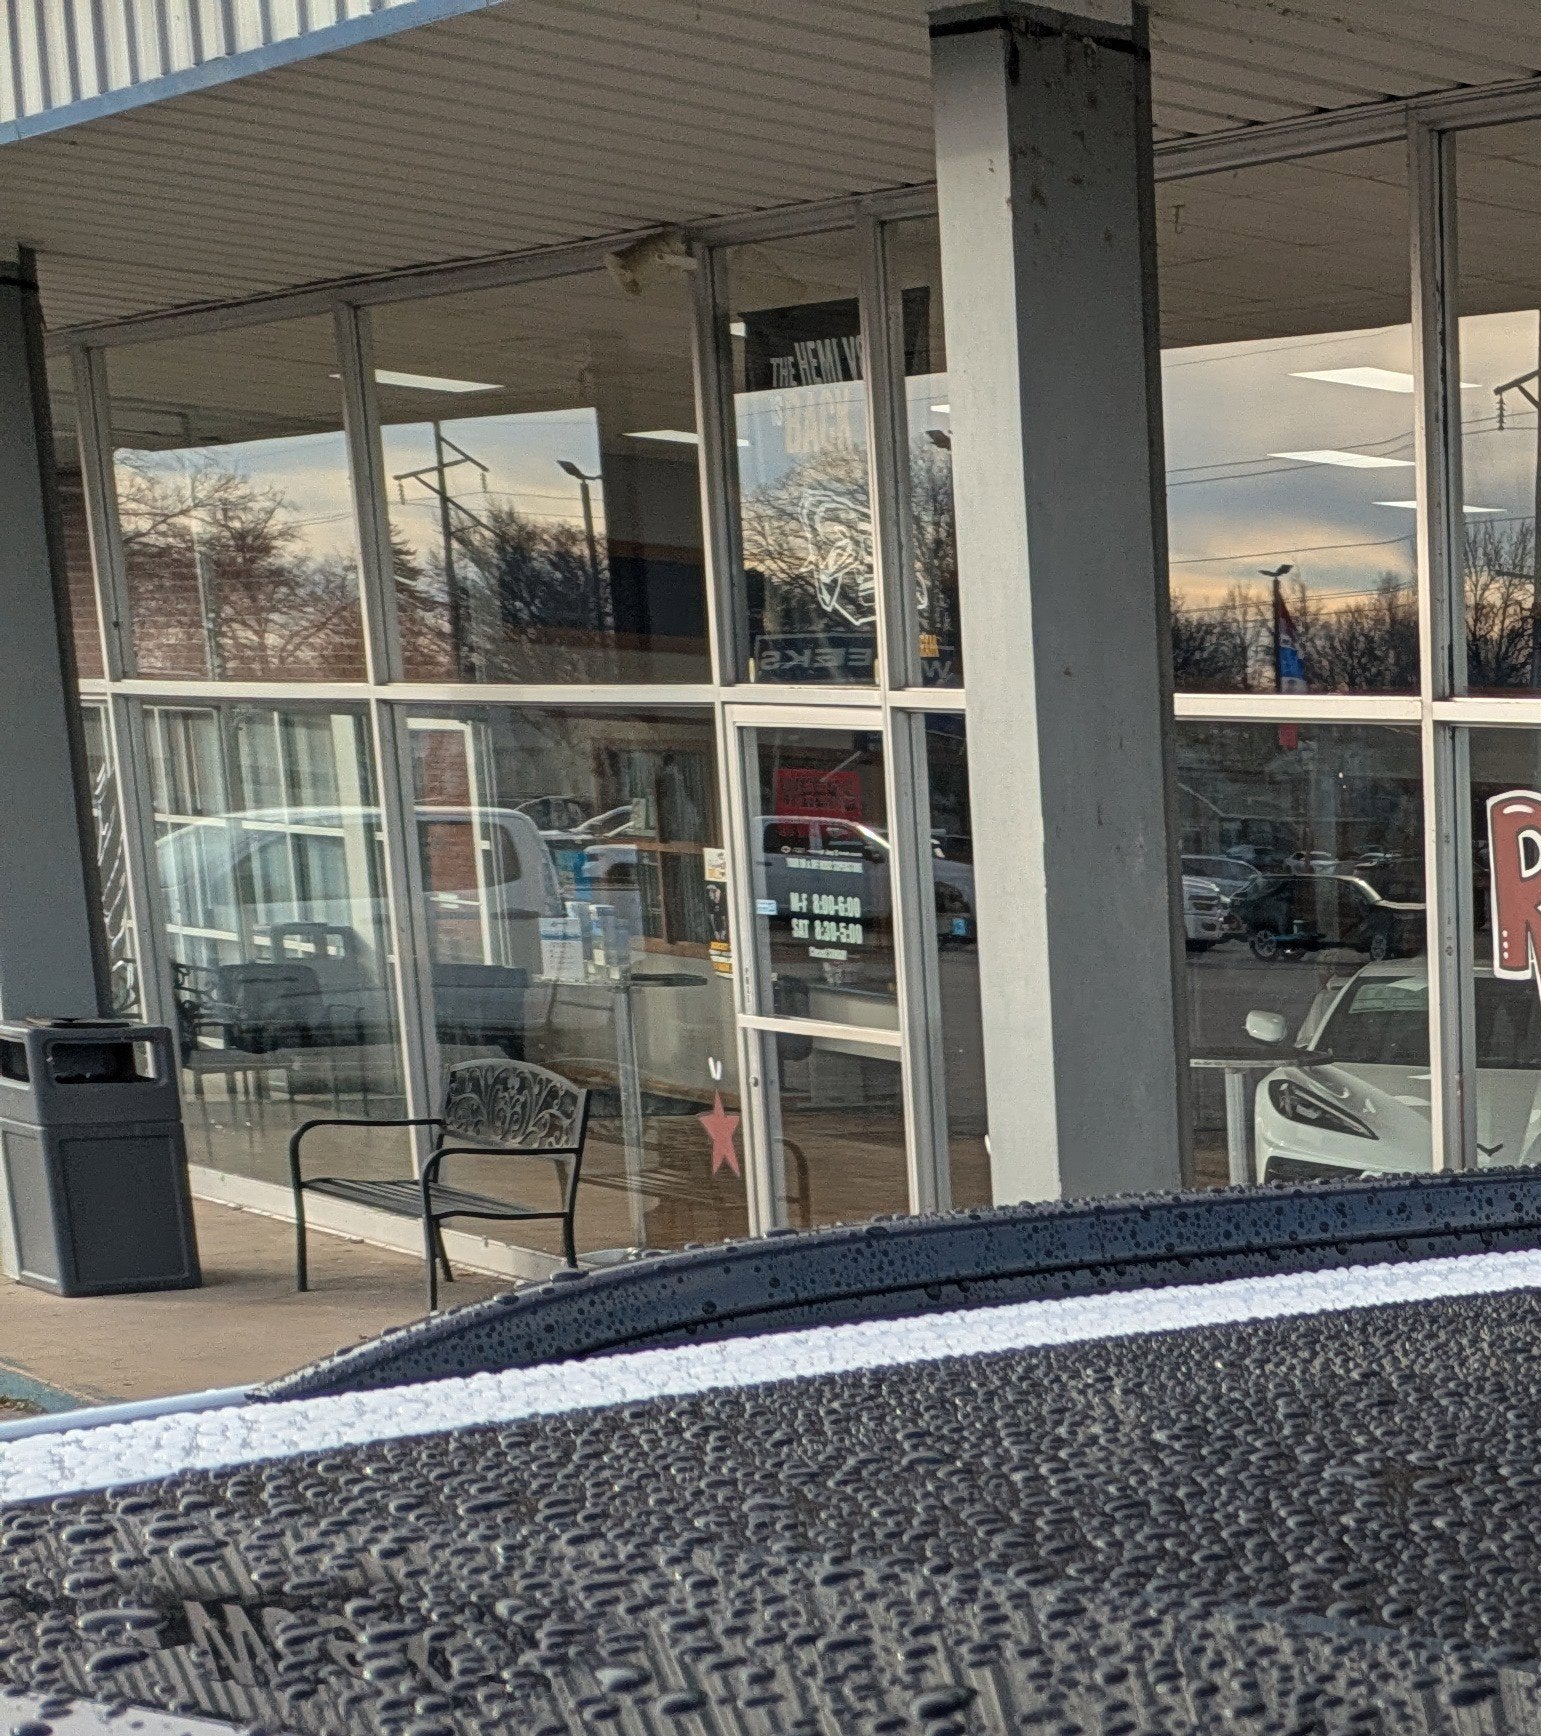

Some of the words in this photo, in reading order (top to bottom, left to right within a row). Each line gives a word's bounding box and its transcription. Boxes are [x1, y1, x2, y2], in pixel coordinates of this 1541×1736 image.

[770, 356, 798, 388] THE
[794, 337, 843, 386] HEMI
[790, 917, 810, 939] SAT
